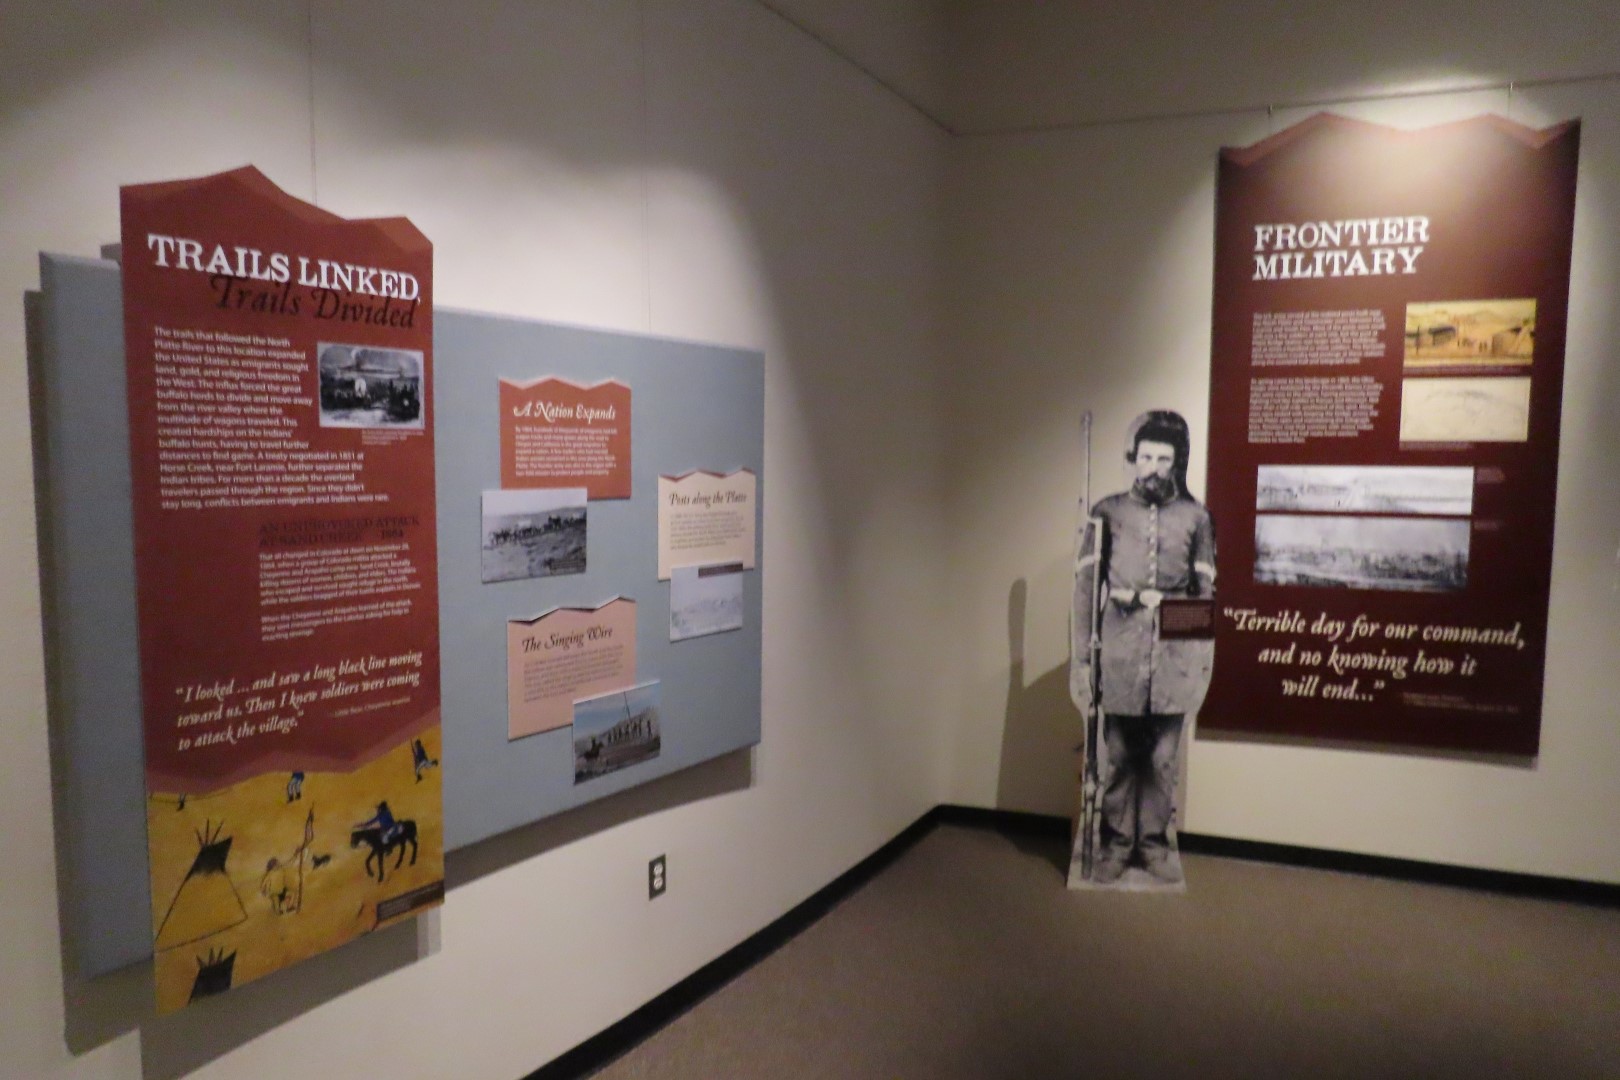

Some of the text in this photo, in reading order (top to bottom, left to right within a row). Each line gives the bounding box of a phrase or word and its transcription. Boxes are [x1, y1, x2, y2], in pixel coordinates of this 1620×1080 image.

[1254, 216, 1430, 251] FRONTIER
[147, 234, 421, 302] TRAILS LINKED,
[1252, 247, 1423, 280] MILITARY
[210, 274, 418, 328] Trails Divided
[156, 327, 290, 347] The trails that followed the North
[155, 340, 180, 350] Platte
[182, 342, 204, 352] River
[206, 344, 215, 353] to
[217, 345, 232, 354] this
[156, 353, 171, 362] the
[173, 354, 202, 364] United
[204, 356, 228, 365] States
[283, 360, 308, 372] sought
[204, 369, 220, 378] and
[292, 374, 300, 383] in
[156, 378, 171, 387] the
[199, 380, 214, 389] The
[240, 382, 266, 391] forced
[268, 383, 280, 392] the
[282, 384, 301, 395] great
[157, 390, 188, 400] buffalo
[216, 393, 224, 401] to
[227, 393, 252, 402] divide
[254, 394, 268, 403] and
[293, 397, 312, 407] away
[158, 403, 282, 416] from the river valley where the
[513, 400, 615, 424] A Nation Expands
[203, 417, 212, 425] of
[214, 418, 246, 428] wagons
[283, 418, 297, 427] This
[158, 428, 191, 437] created
[194, 428, 234, 439] hardships
[248, 429, 262, 438] the
[159, 440, 190, 448] buffalo
[220, 440, 248, 451] having
[250, 440, 258, 449] to
[260, 440, 281, 449] travel
[160, 452, 200, 460] distances
[202, 452, 211, 460] to
[213, 452, 230, 460] find
[257, 452, 263, 460] A
[265, 452, 288, 462] treaty
[290, 452, 330, 462] negotiated
[331, 452, 337, 460] in
[357, 452, 364, 460] at
[160, 464, 186, 472] Horse
[236, 463, 252, 472] Fort
[315, 463, 350, 473] separated
[351, 463, 363, 471] the
[160, 476, 188, 484] Indian
[219, 475, 231, 483] For
[256, 474, 274, 483] than
[282, 474, 309, 482] decade
[311, 473, 322, 482] the
[161, 487, 198, 496] travelers
[200, 486, 230, 497] passed
[231, 486, 264, 497] through
[265, 485, 278, 494] the
[307, 484, 327, 493] Since
[328, 484, 343, 495] they
[162, 499, 179, 510] stay
[205, 498, 239, 507] conflicts
[241, 497, 275, 506] between
[316, 495, 330, 504] and
[330, 494, 356, 503] Indians
[669, 491, 747, 509] Posts along the Platte
[1223, 607, 1305, 633] "Terrible
[1311, 612, 1345, 642] day
[1346, 614, 1380, 643] for
[1385, 623, 1417, 640] our
[1423, 622, 1525, 650] command,
[522, 626, 612, 653] The Singing Wire
[1258, 642, 1477, 680] and no knowing how it
[196, 679, 233, 703] looked
[252, 673, 275, 690] and
[280, 673, 300, 686] saw
[303, 672, 310, 681] a
[314, 665, 335, 682] long
[339, 660, 367, 675] black
[368, 656, 386, 671] line
[389, 650, 422, 667] moving
[1282, 675, 1319, 697] will
[178, 704, 221, 728] toward
[226, 706, 242, 718] us.
[246, 697, 275, 714] Then
[280, 695, 287, 707] I
[290, 691, 317, 709] knew
[321, 682, 359, 700] soldiers
[362, 678, 384, 692] were
[386, 671, 420, 687] coming
[179, 738, 190, 752] to
[195, 728, 237, 748] attack
[237, 721, 255, 739] the
